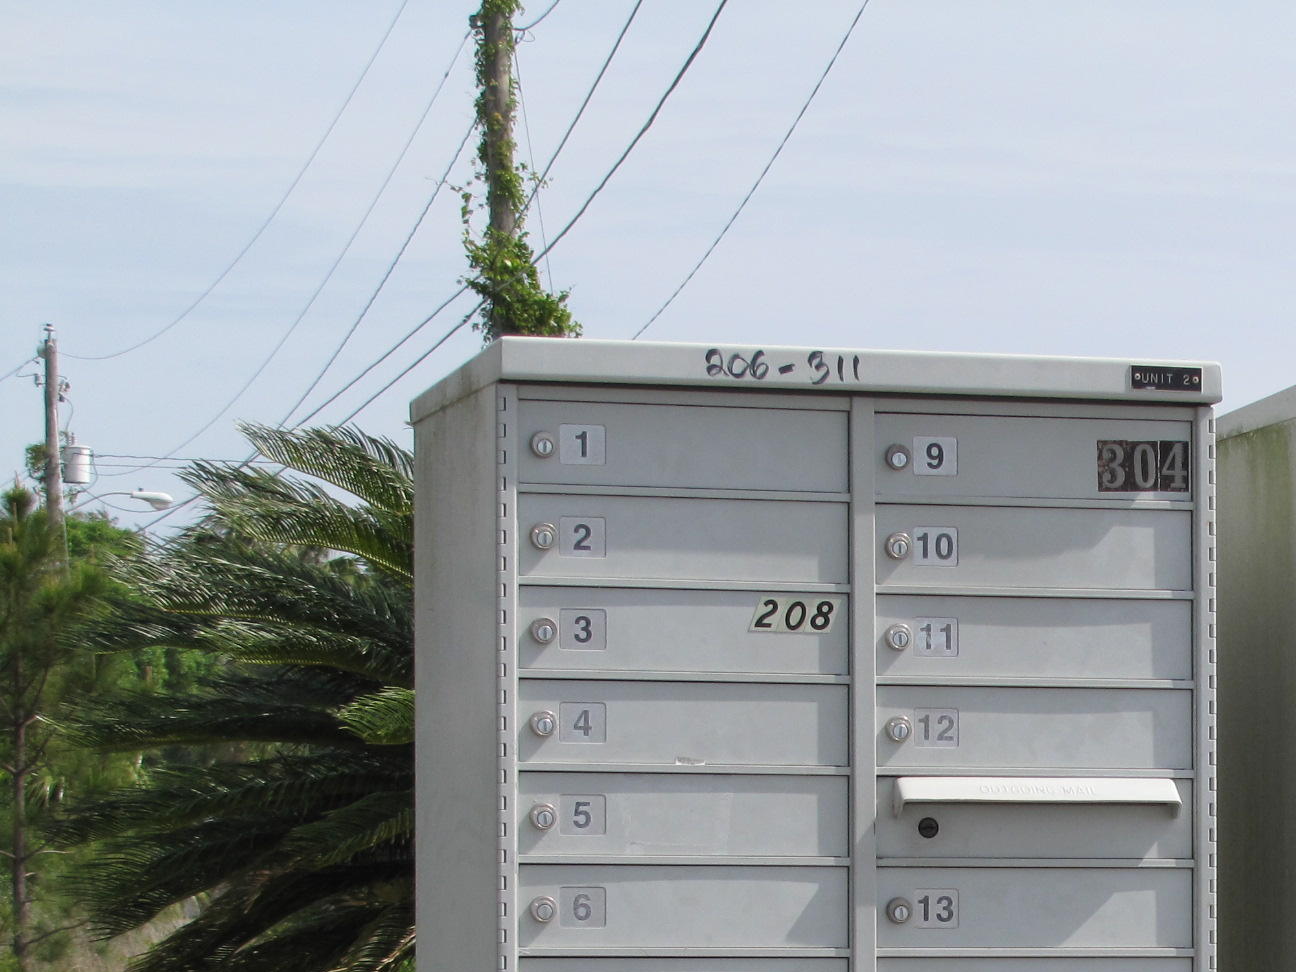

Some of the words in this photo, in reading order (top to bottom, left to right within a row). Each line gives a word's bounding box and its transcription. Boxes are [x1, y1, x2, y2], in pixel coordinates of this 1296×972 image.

[1141, 372, 1173, 384] UNIT
[1183, 374, 1190, 385] 2
[575, 431, 589, 458] 1
[925, 443, 944, 469] 9
[1100, 443, 1188, 490] 304
[573, 524, 592, 551] 2
[916, 534, 955, 560] 10
[754, 600, 835, 631] 208
[573, 616, 593, 643] 3
[918, 624, 954, 651] 11
[573, 710, 593, 736] 4
[917, 716, 955, 741] 12
[572, 802, 592, 829] 5
[572, 894, 592, 921] 6
[917, 896, 954, 922] 13
